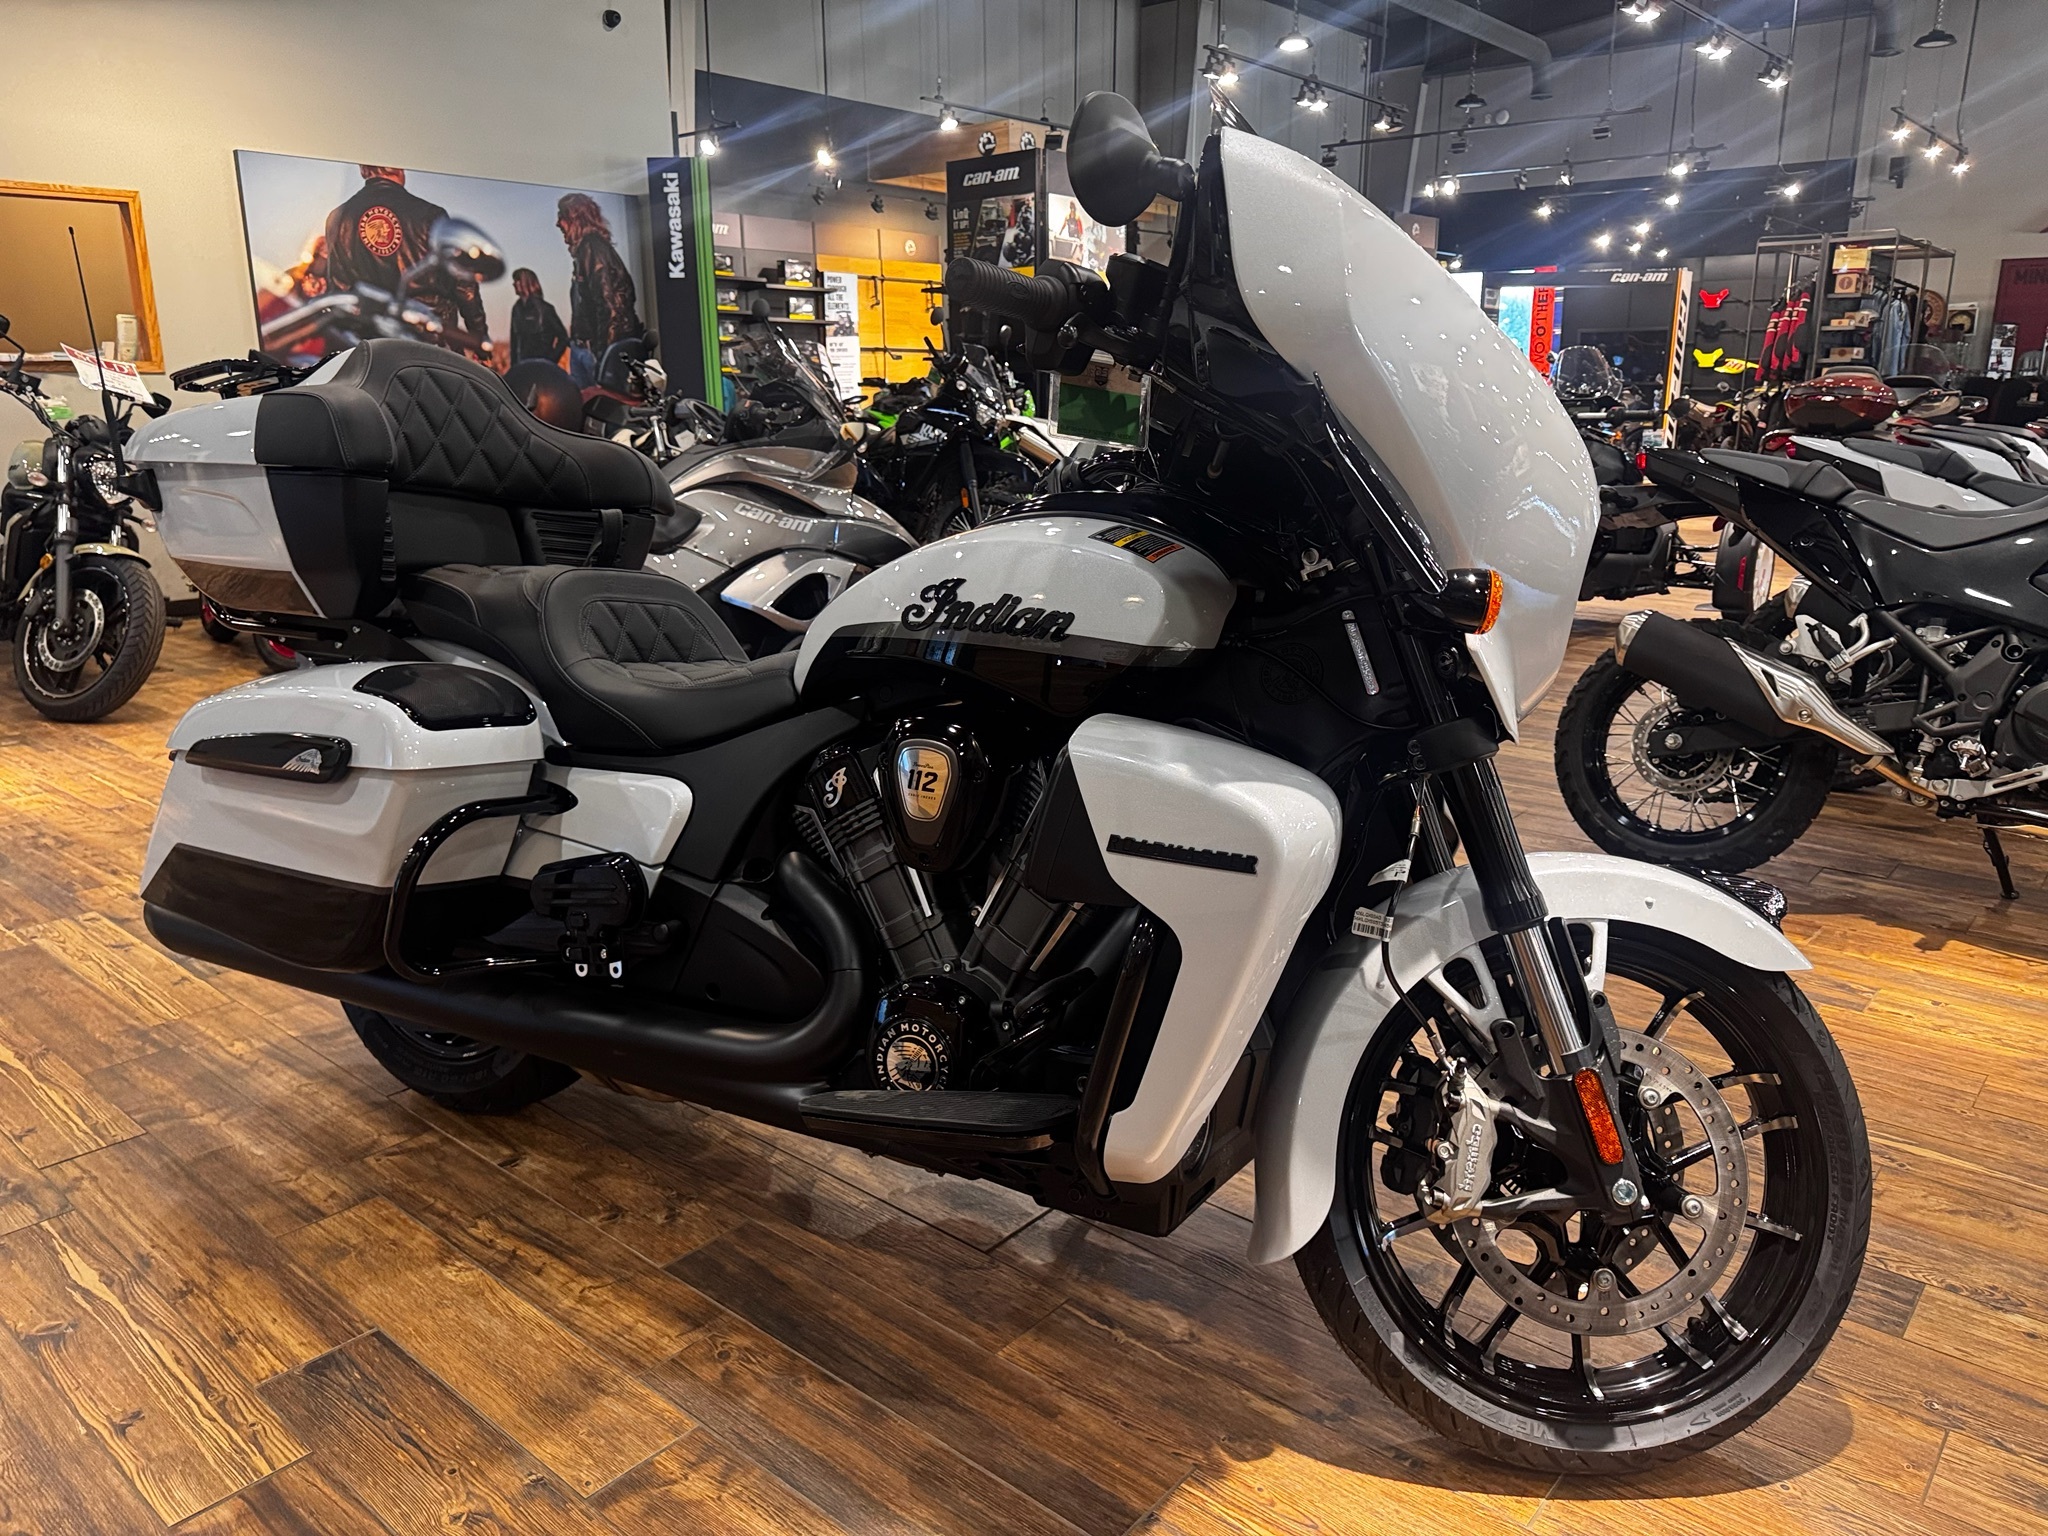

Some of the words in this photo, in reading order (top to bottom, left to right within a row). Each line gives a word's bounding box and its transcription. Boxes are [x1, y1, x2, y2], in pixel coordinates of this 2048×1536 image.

[963, 166, 1020, 187] can-am
[662, 172, 685, 278] Kawasaki
[1610, 272, 1669, 283] can-am
[733, 502, 813, 533] can-am
[901, 577, 1076, 642] Indian
[907, 769, 938, 793] 112
[876, 1028, 896, 1082] INDIAN
[900, 1022, 949, 1091] MOTORCYCL
[1458, 1123, 1482, 1193] brembo
[1826, 1191, 1840, 1245] FRONT
